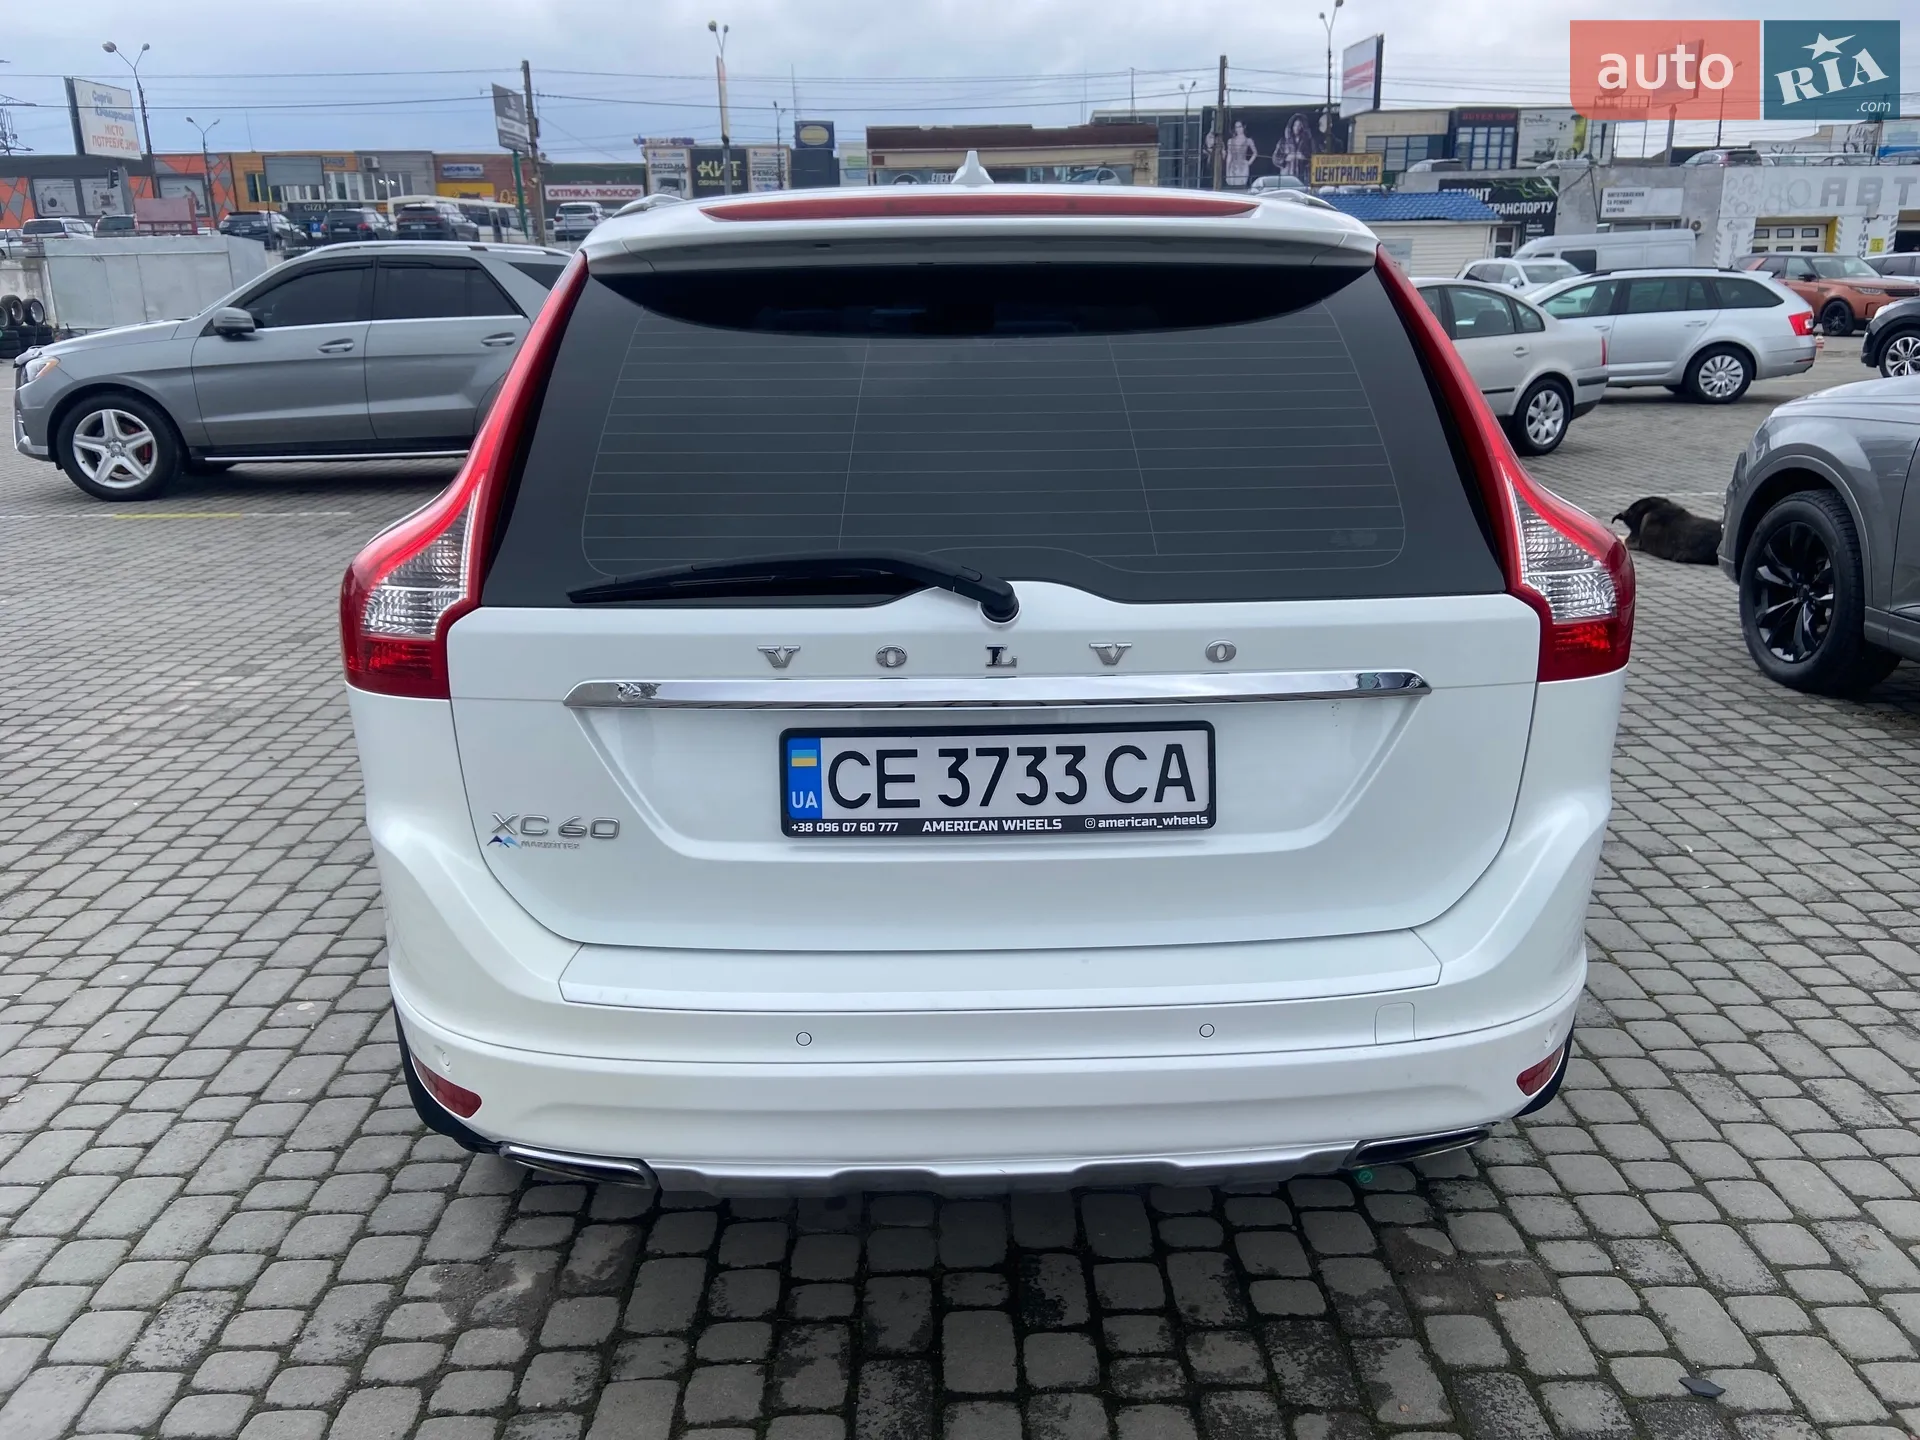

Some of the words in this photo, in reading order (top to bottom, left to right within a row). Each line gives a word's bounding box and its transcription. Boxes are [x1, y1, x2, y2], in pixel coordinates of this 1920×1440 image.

[1315, 166, 1379, 181] ЦЕНТРАЛЬНА
[756, 639, 1237, 670] VOLVO
[827, 749, 920, 809] CE
[937, 745, 1088, 808] 3733
[1103, 743, 1196, 803] CA
[791, 791, 818, 809] UA
[791, 822, 813, 833] +38
[816, 822, 839, 833] 096
[842, 822, 857, 832] 07
[859, 822, 875, 832] 60
[878, 822, 899, 832] 777
[922, 820, 998, 833] AMERICAN
[1001, 818, 1062, 831] WHEELS
[1097, 814, 1208, 829] american_wheels
